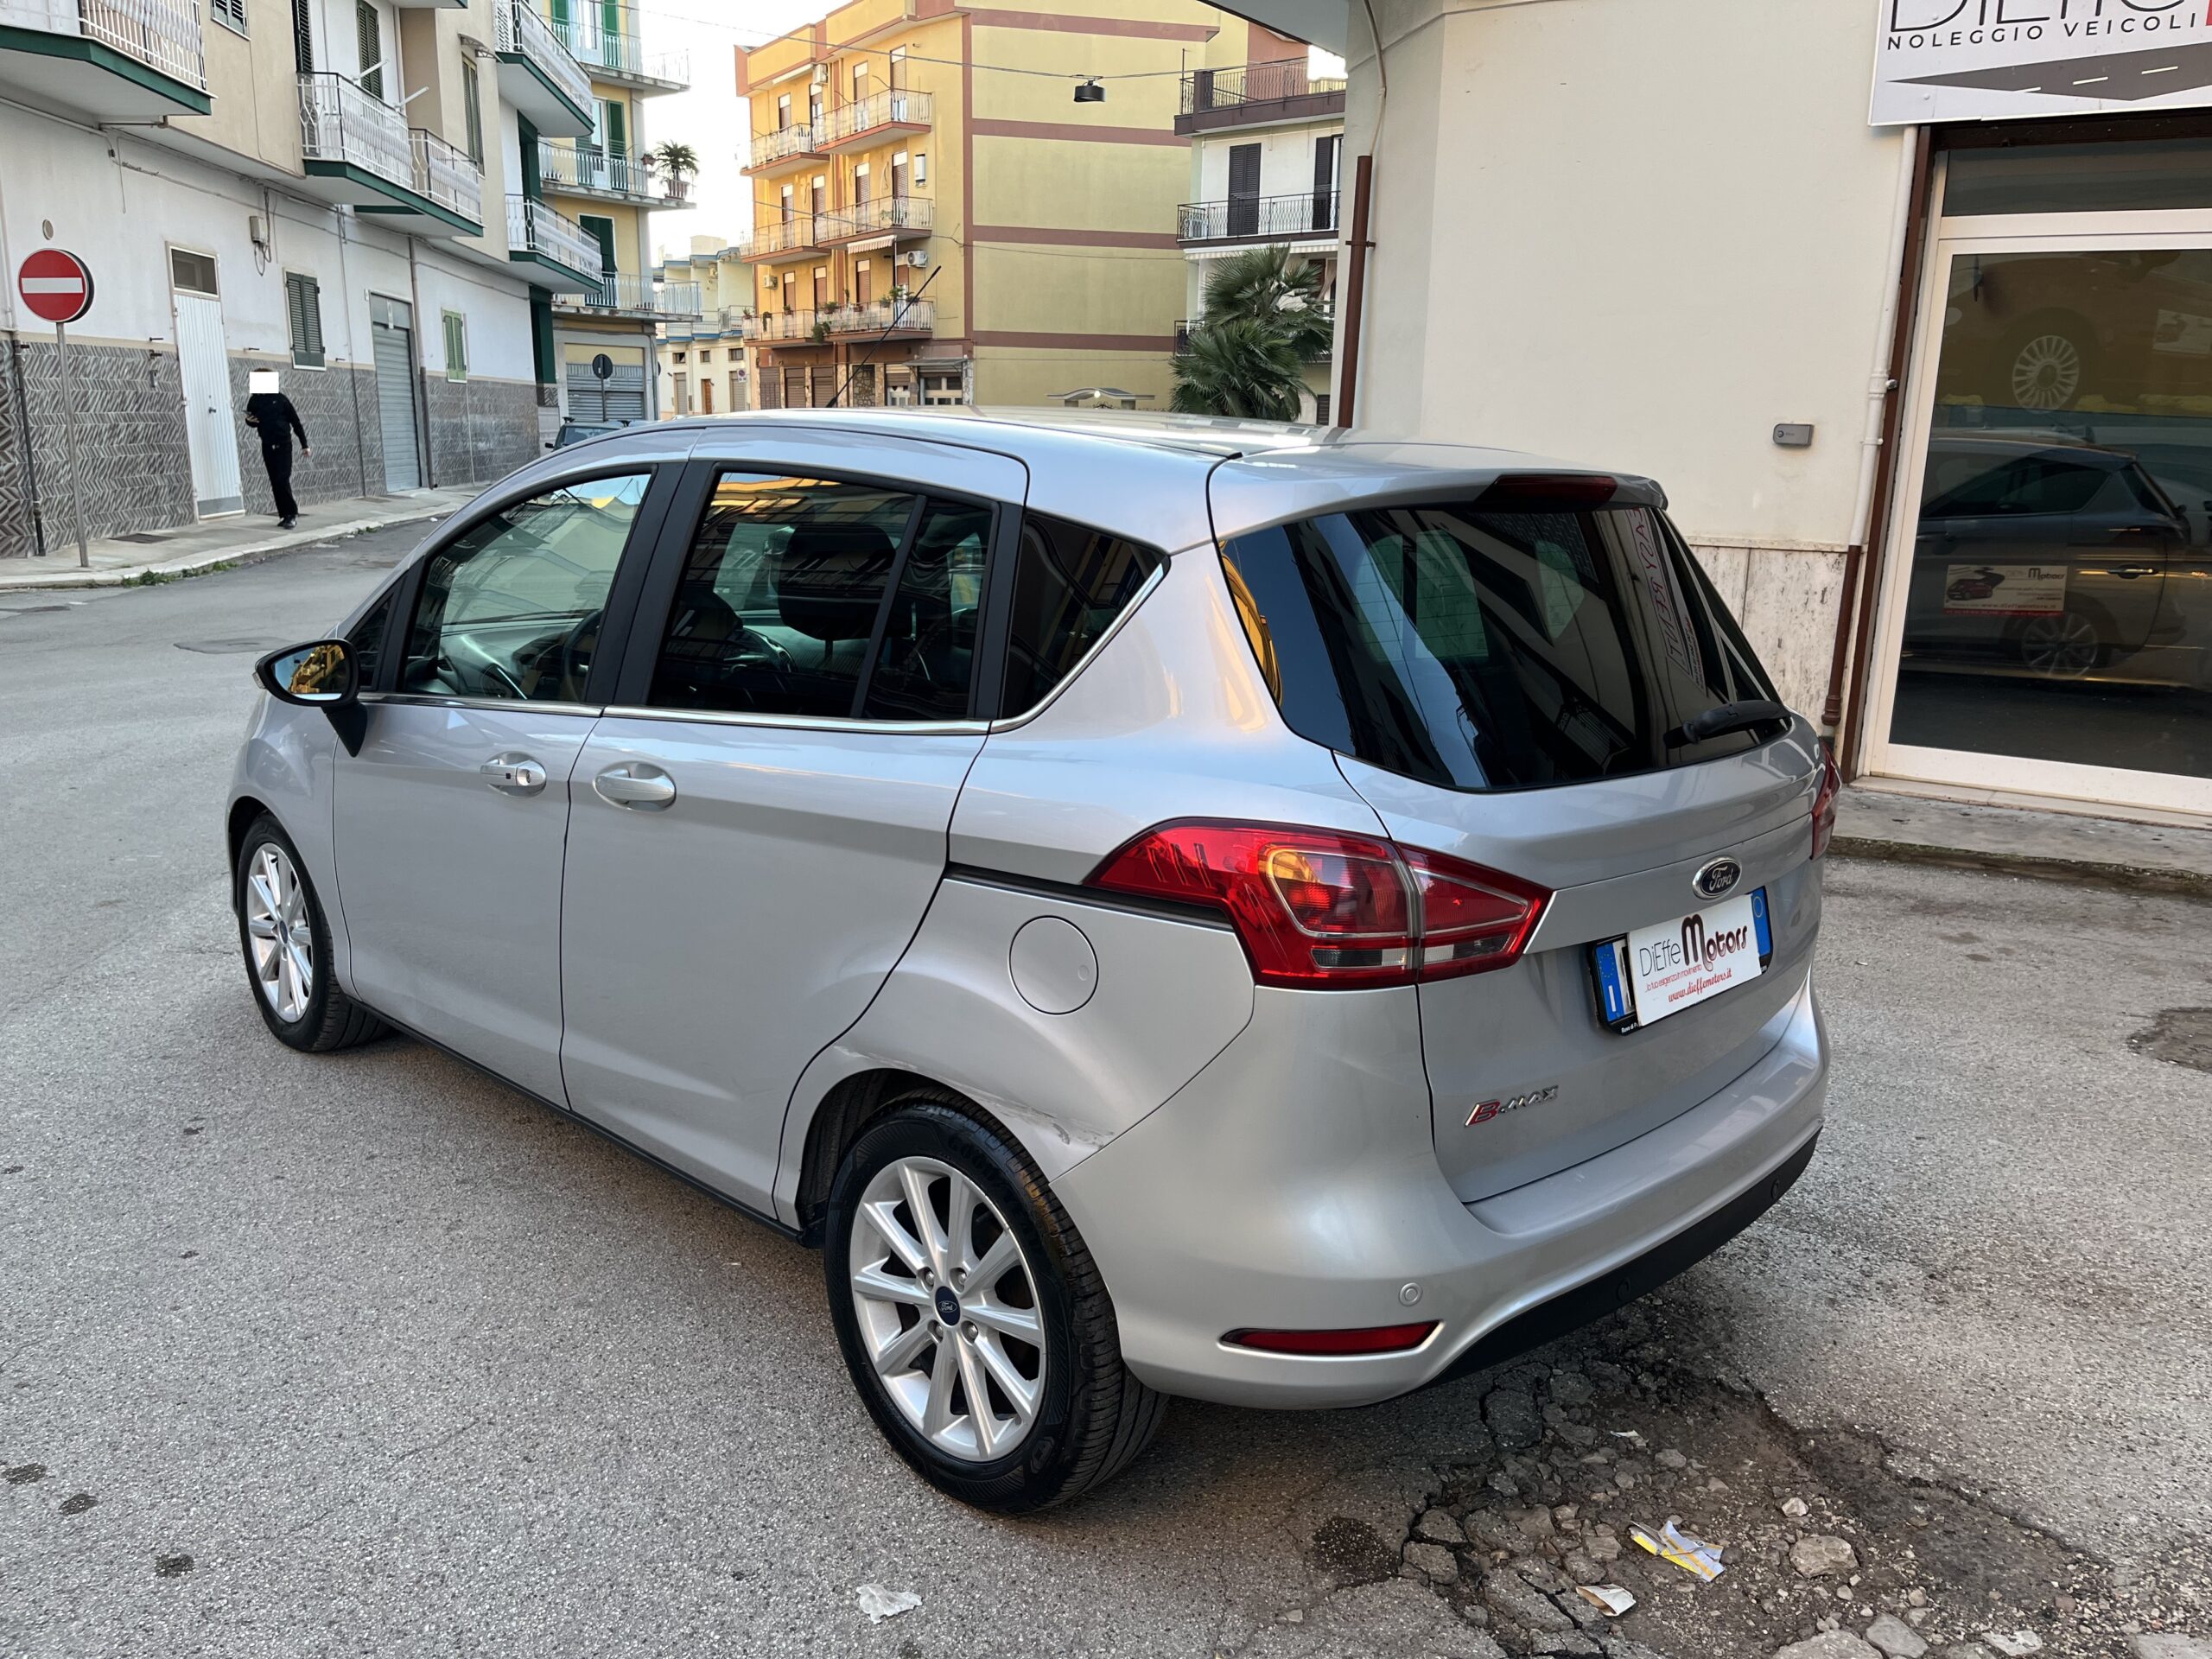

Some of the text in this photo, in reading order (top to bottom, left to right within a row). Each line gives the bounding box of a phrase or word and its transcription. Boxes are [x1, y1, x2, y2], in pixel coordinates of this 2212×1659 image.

[1888, 26, 2043, 50] NOLEGGIO
[2064, 13, 2196, 37] VEICOLI
[1708, 866, 1734, 892] Ford
[1639, 913, 1747, 976] DiEffe Motors
[1668, 968, 1732, 1002] www.dieffemotors.it
